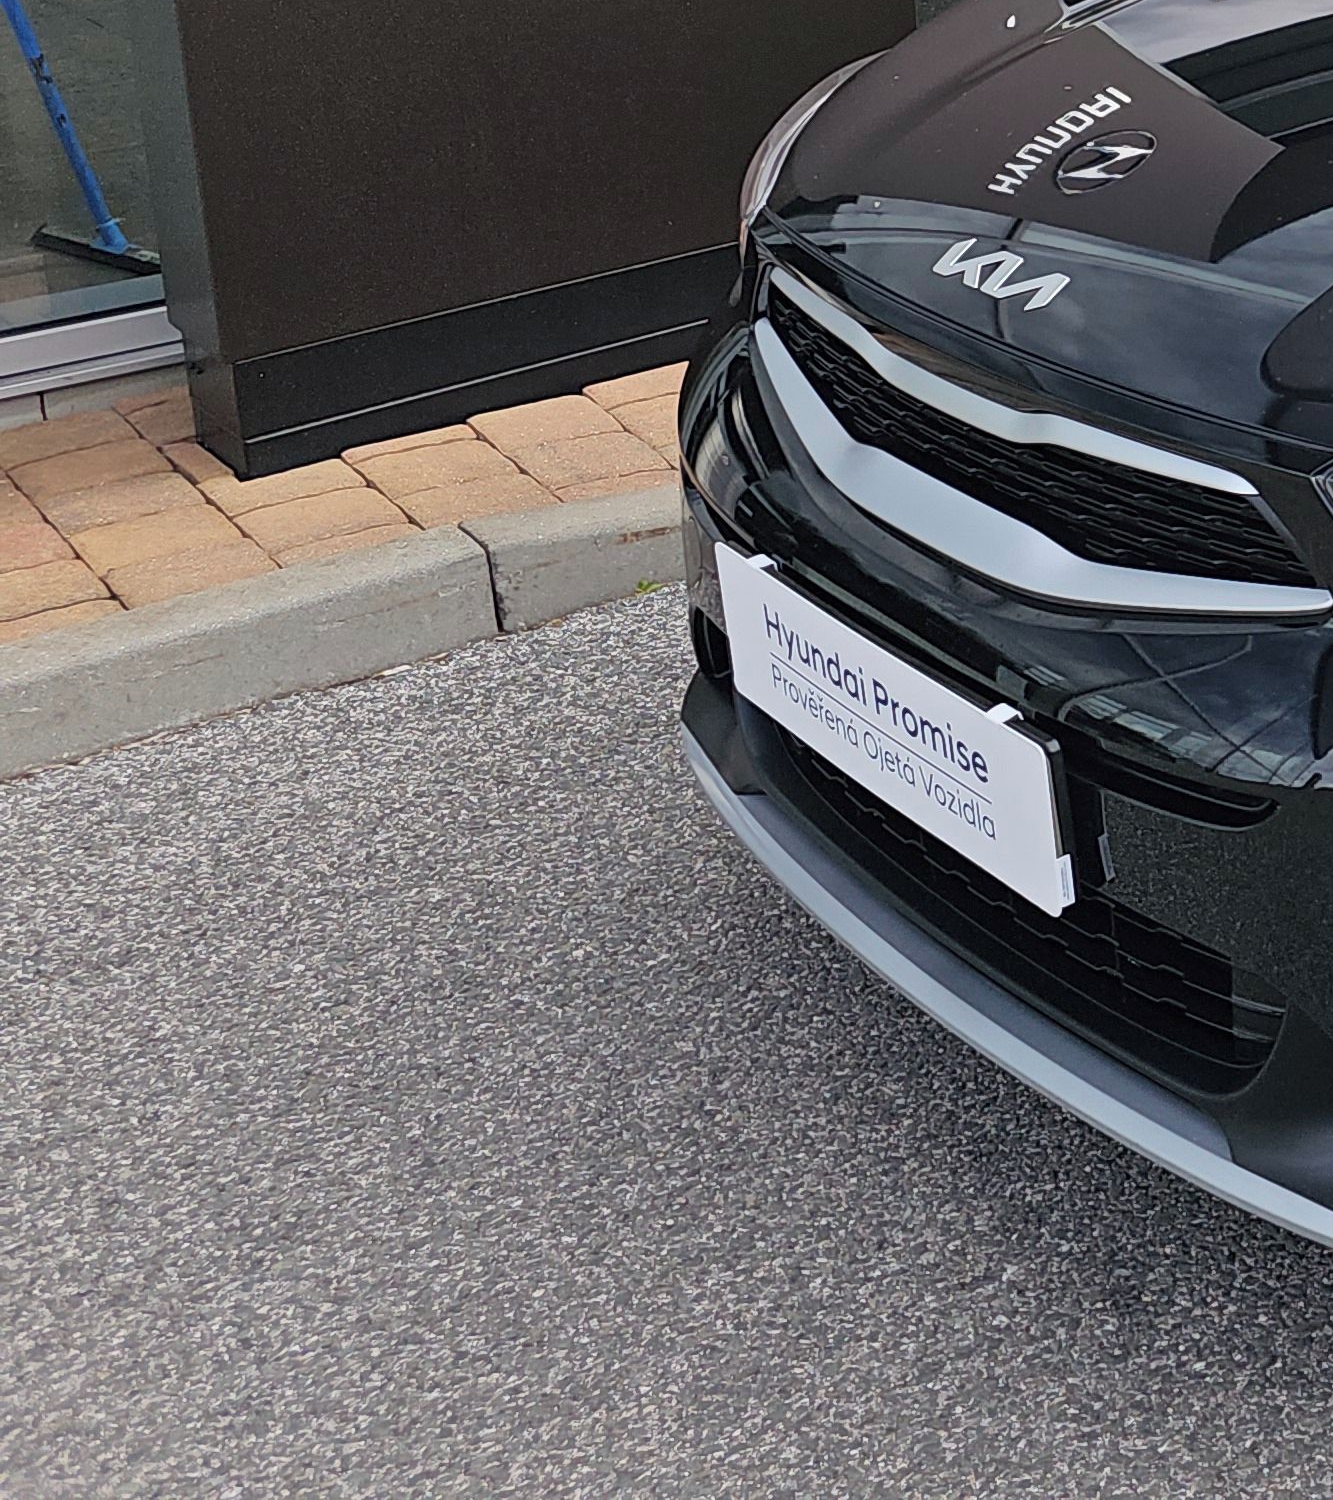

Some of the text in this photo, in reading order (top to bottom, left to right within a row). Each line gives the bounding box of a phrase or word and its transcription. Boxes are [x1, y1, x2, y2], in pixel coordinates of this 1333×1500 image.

[932, 238, 1071, 312] KIA
[763, 604, 990, 784] Hyundai Promise
[771, 663, 997, 841] Prověřená Ojetá Vozidla
